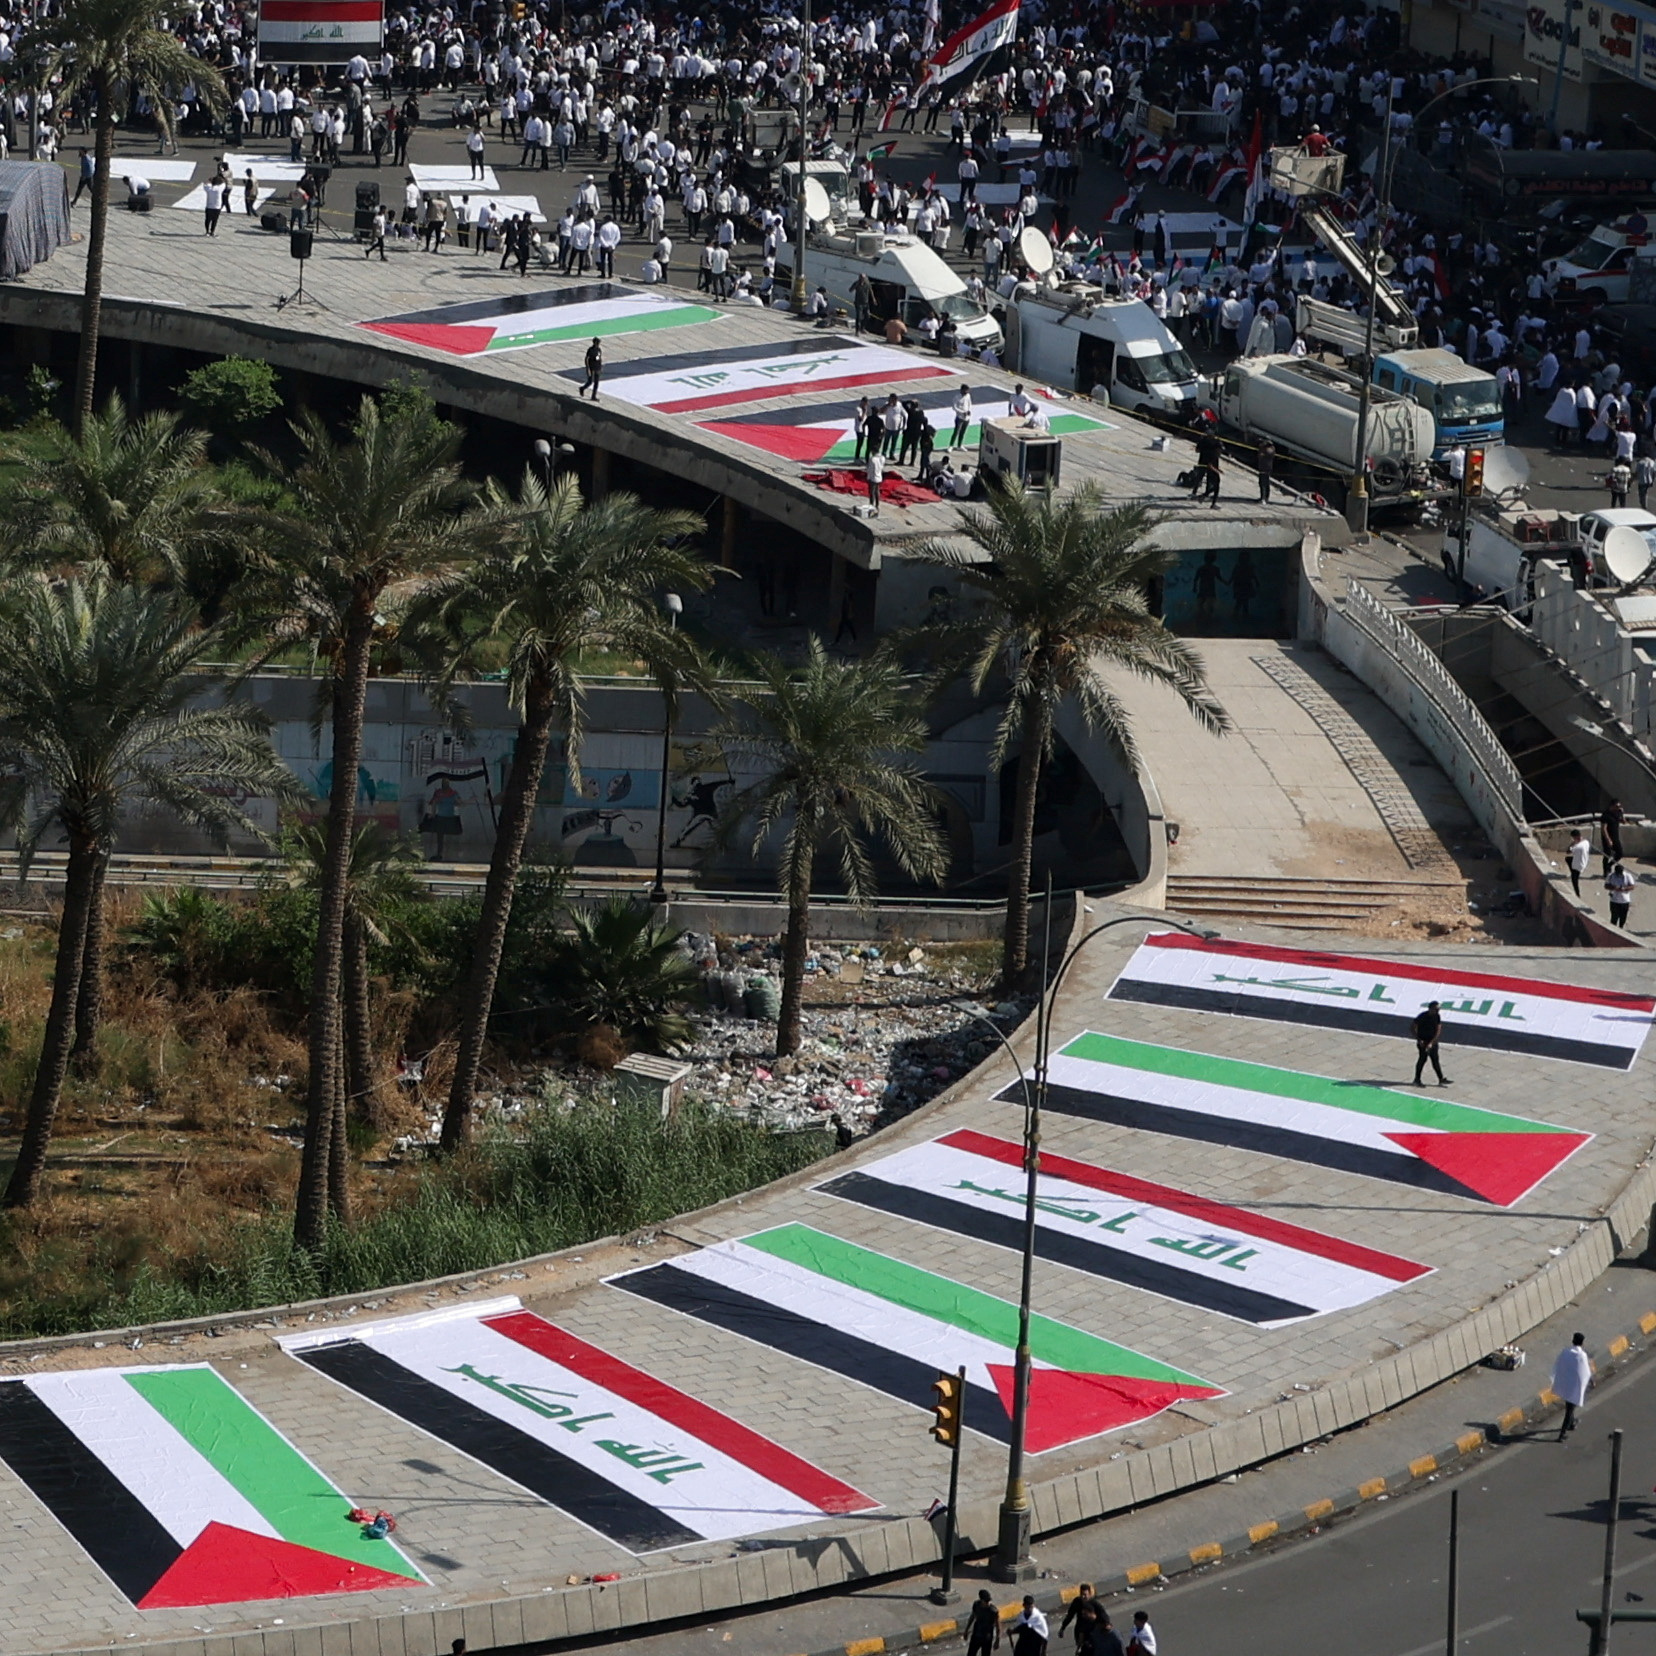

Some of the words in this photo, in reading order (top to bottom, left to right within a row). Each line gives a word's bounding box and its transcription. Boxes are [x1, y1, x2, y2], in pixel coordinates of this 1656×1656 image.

[329, 24, 344, 39] الله
[1148, 1233, 1259, 1272] الله
[594, 1437, 707, 1486] الله
